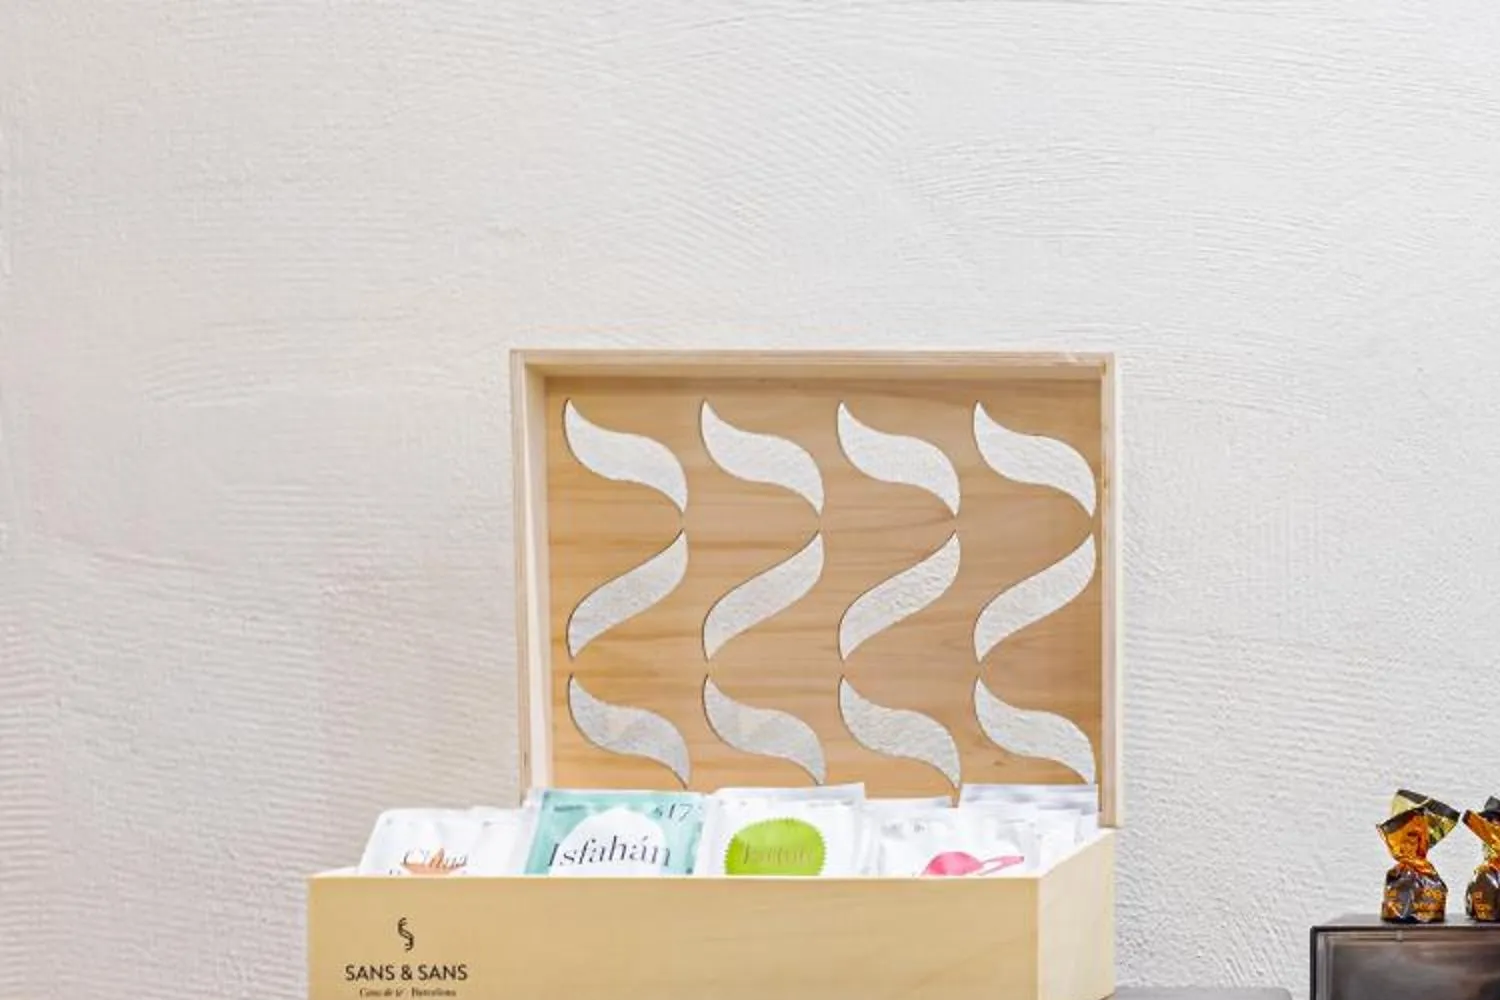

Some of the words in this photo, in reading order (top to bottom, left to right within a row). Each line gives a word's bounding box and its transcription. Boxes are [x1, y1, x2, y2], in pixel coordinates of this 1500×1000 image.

[345, 963, 395, 981] SANS
[401, 964, 413, 981] &
[418, 963, 468, 981] SANS
